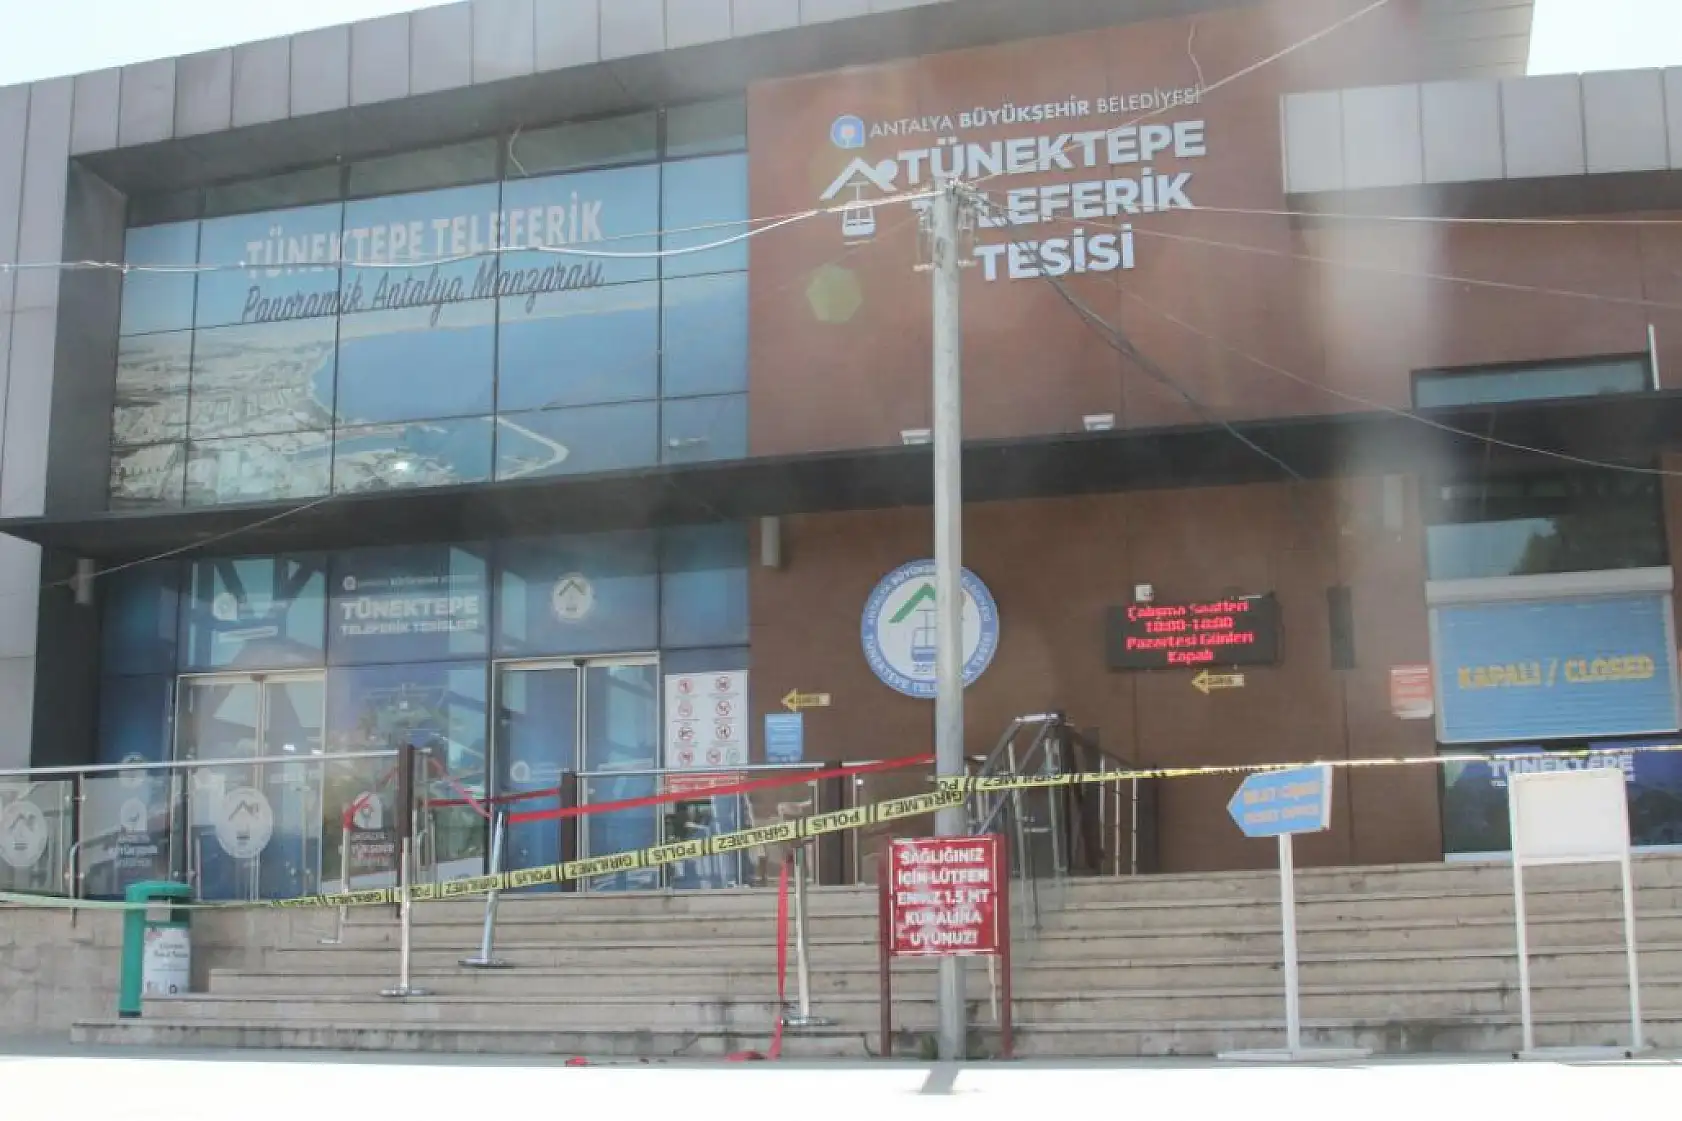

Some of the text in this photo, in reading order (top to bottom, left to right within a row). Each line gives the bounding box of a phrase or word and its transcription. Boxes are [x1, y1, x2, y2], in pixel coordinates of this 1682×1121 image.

[870, 83, 1200, 139] ANTALYA BÜYÜKŞEHİR BELEDİYESİ
[897, 120, 1206, 184] TÜNEKTEPE
[246, 190, 603, 279] TÜNEKTEPE TELEFERİK
[972, 222, 1135, 282] TESİSİ
[241, 254, 605, 328] Panoramik Antalya Manzarası
[340, 595, 479, 620] TÜNEKTEPE
[1457, 659, 1541, 690] KAPALI
[1564, 653, 1656, 683] CLOSED
